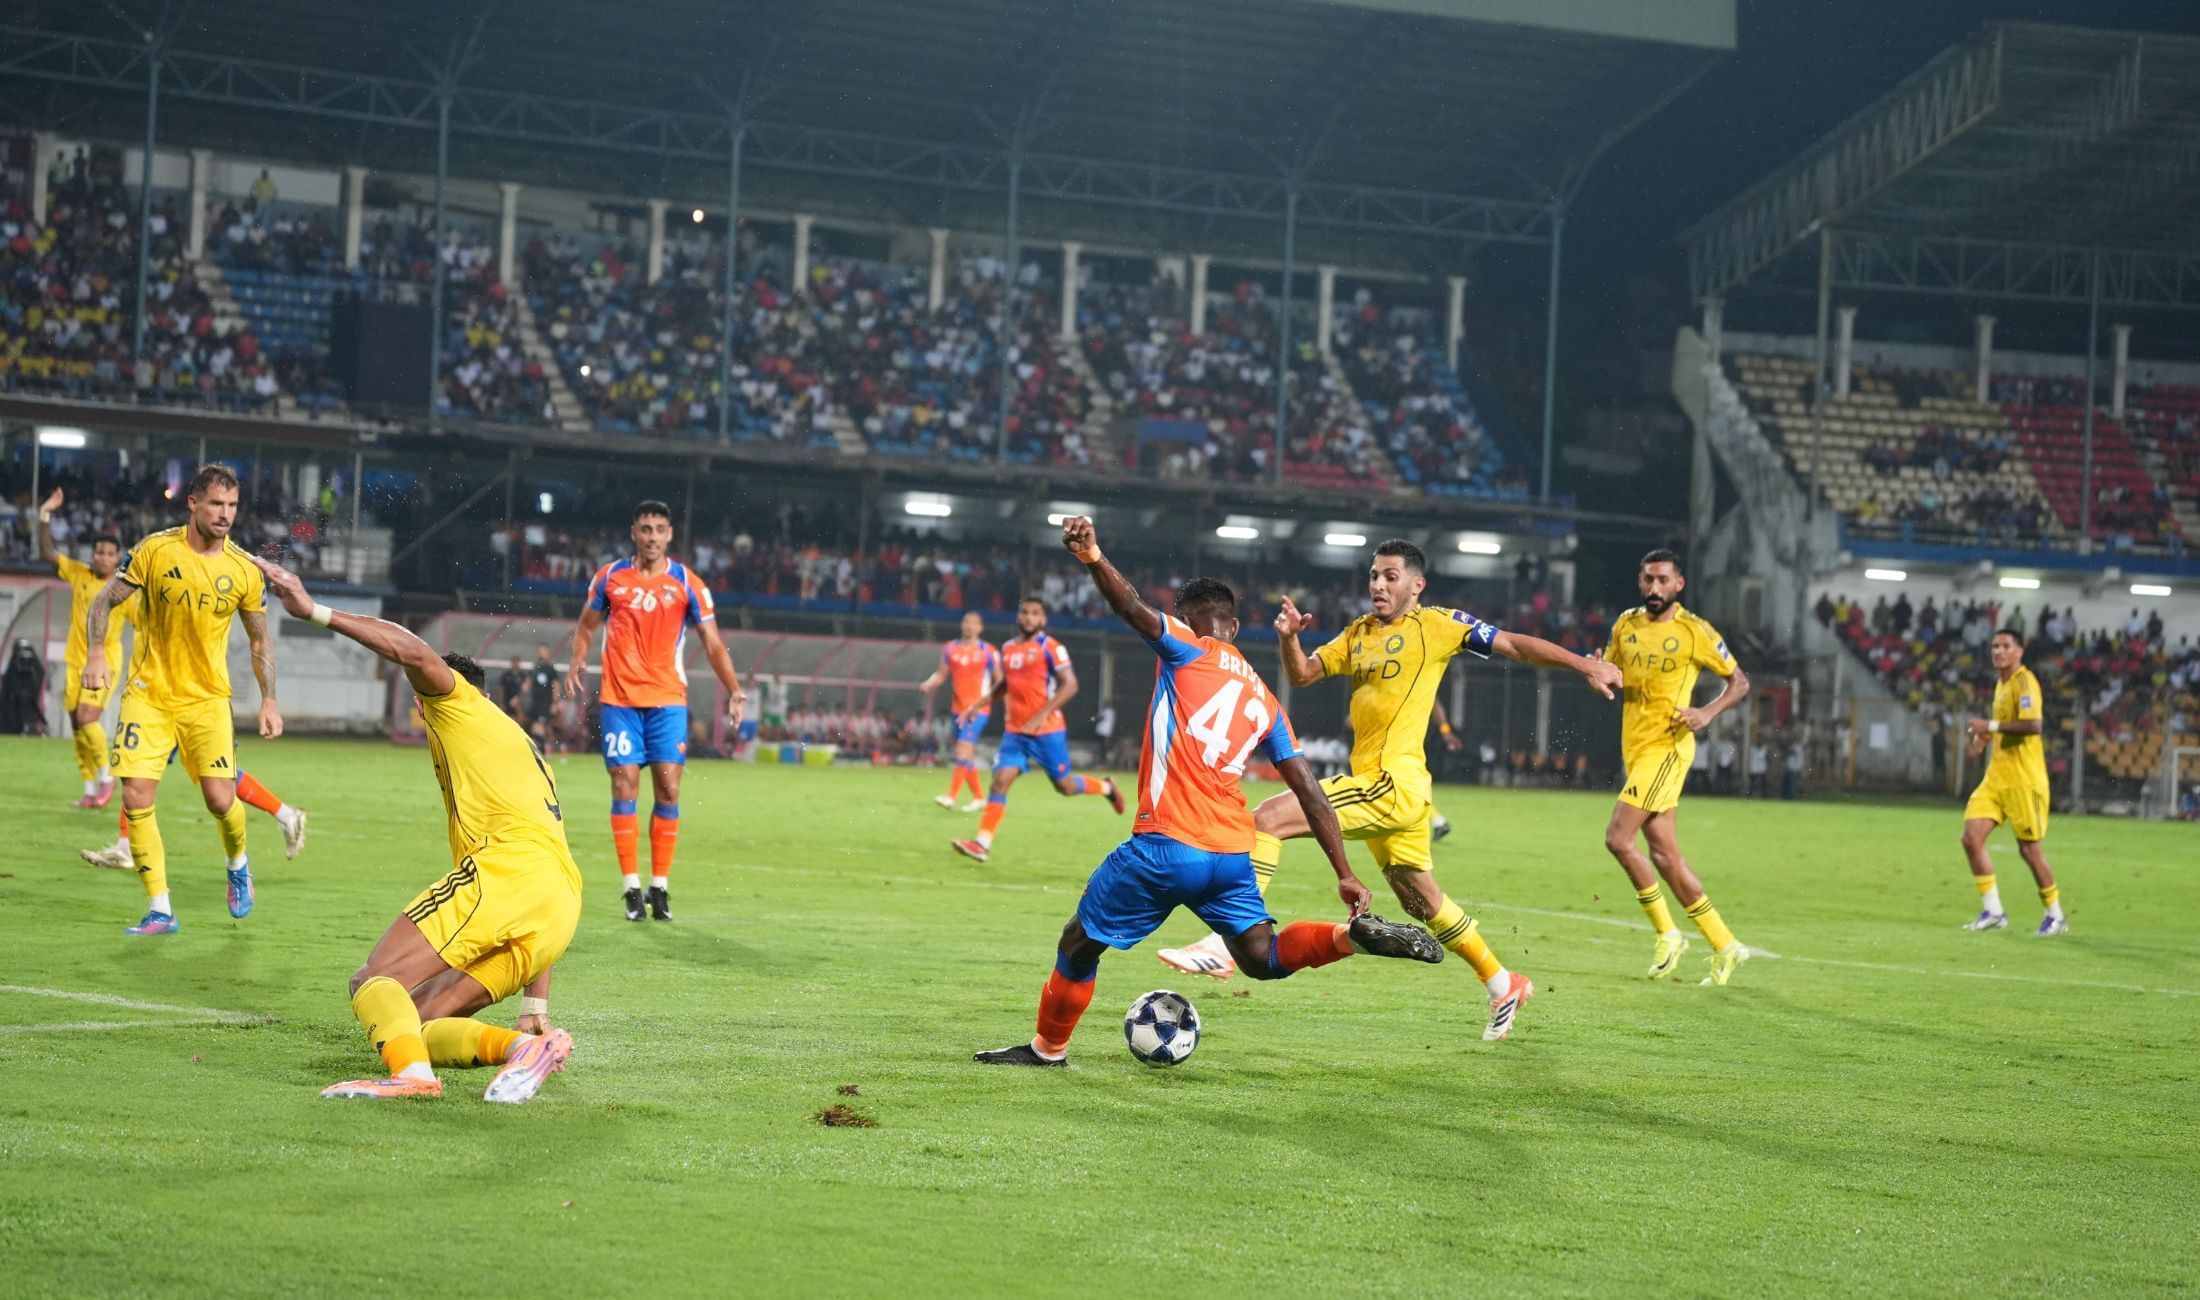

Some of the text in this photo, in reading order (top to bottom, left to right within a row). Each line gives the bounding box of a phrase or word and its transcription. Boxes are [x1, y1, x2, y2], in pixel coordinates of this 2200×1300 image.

[160, 586, 229, 614] KAFD
[628, 587, 657, 612] 26
[1353, 660, 1401, 682] AFD
[1631, 651, 1677, 673] AFD
[1186, 679, 1270, 776] 42
[605, 730, 632, 758] 26
